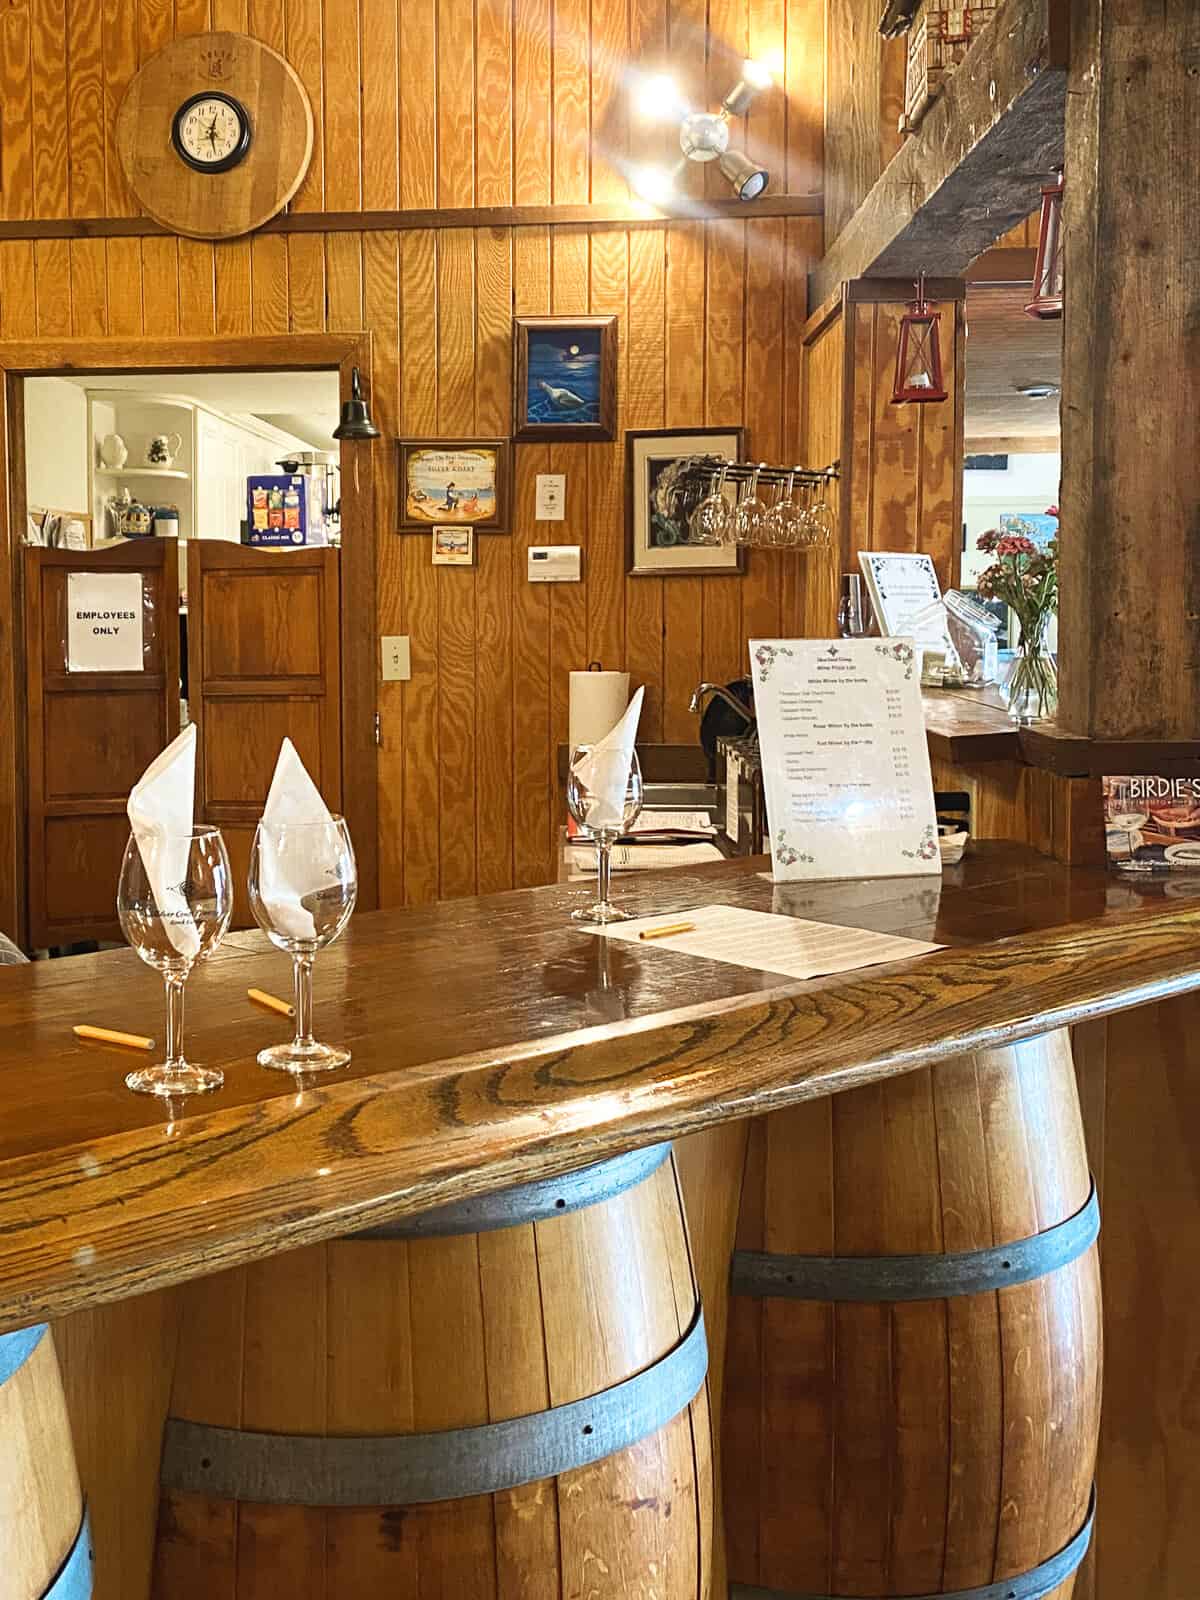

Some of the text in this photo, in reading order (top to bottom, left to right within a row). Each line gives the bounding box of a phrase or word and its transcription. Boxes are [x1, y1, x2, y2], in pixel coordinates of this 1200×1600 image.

[76, 611, 136, 619] EMPLOYEES
[92, 627, 120, 635] ONLY
[1130, 778, 1200, 798] BIRDIE'S
